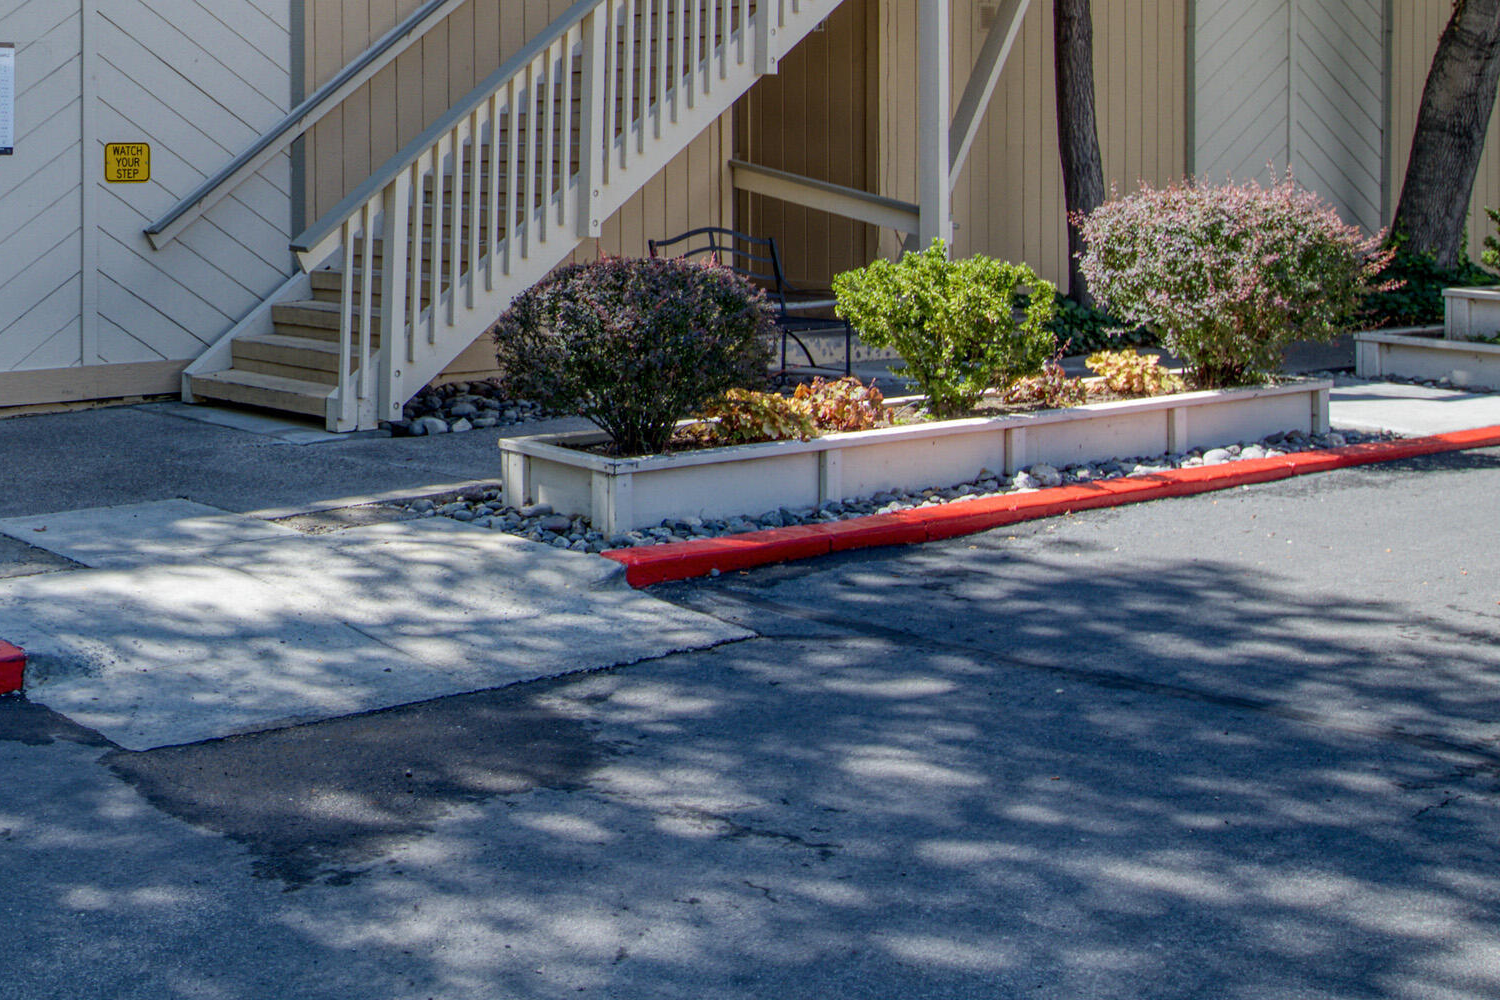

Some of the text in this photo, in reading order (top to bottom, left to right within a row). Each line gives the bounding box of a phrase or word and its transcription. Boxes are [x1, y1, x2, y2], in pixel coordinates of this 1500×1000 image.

[112, 145, 143, 156] WATCH
[115, 157, 140, 167] YOUR
[116, 168, 140, 179] STEP
